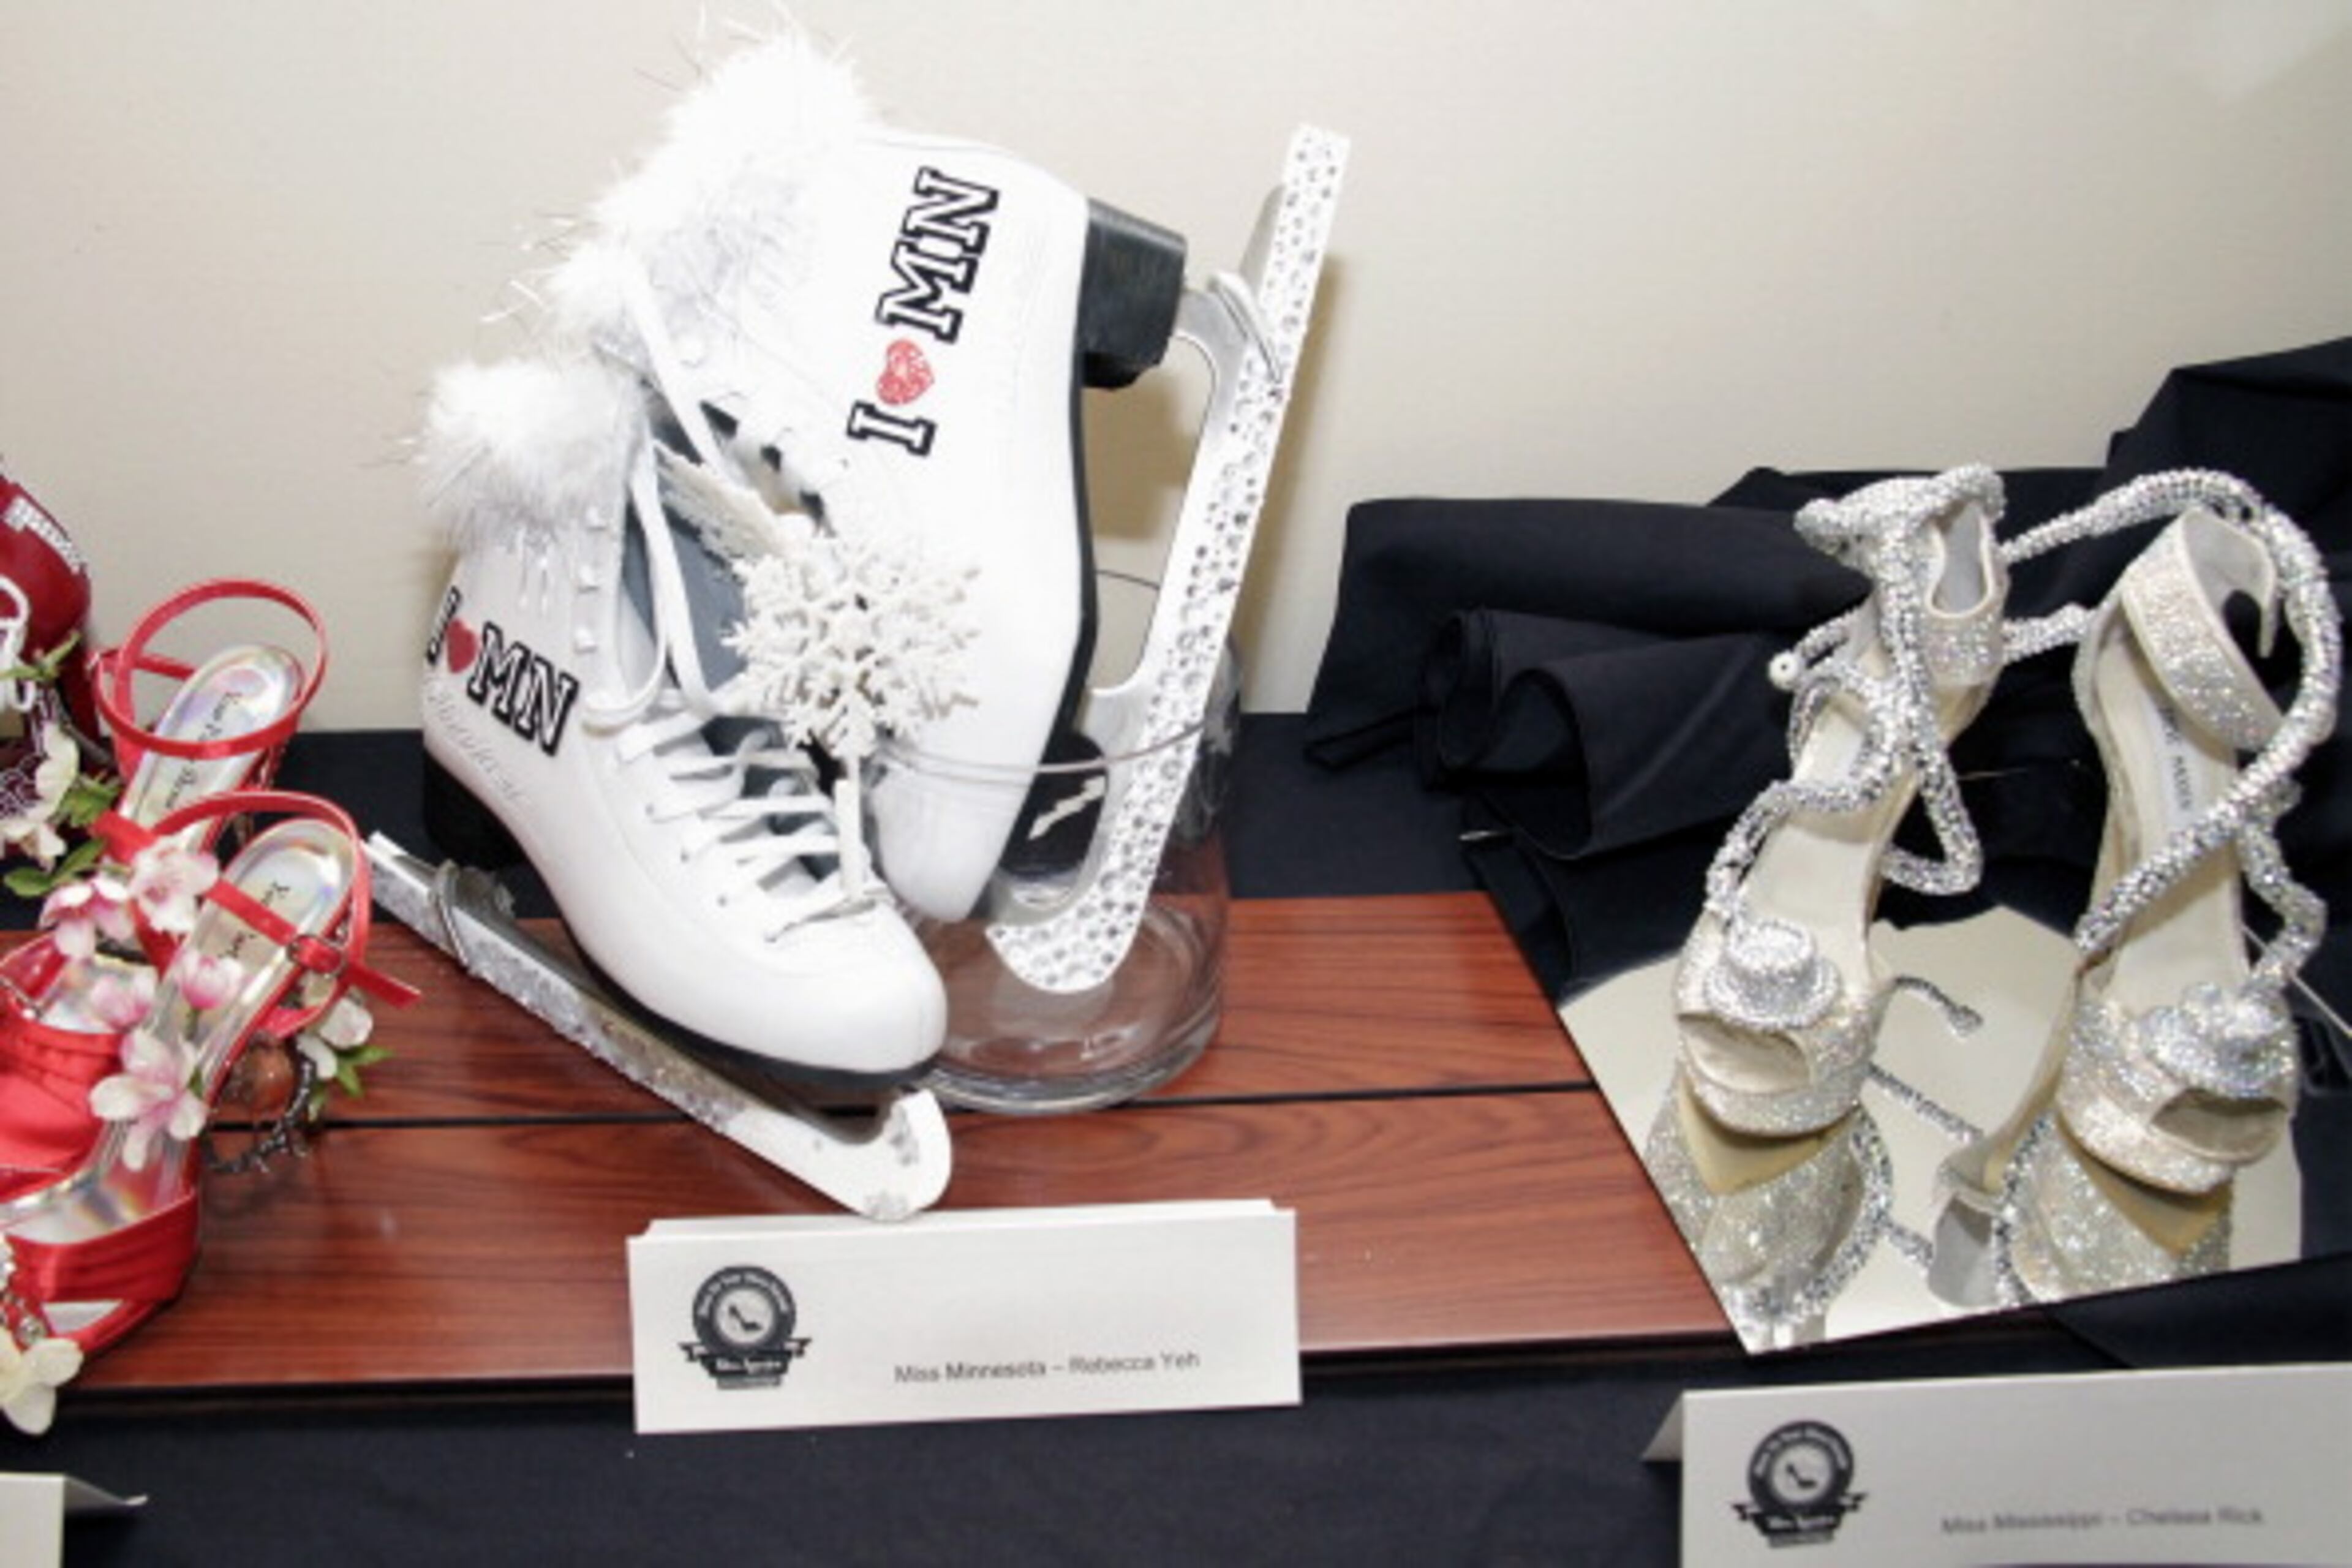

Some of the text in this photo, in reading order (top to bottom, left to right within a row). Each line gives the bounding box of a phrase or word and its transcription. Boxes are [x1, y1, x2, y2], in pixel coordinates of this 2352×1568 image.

[846, 165, 1000, 457] I MN
[467, 621, 580, 758] MN
[894, 1363, 940, 1384] Miss
[945, 1360, 1047, 1381] Minnesota
[1068, 1354, 1155, 1376] Rebecca
[1159, 1351, 1201, 1371] Yeh
